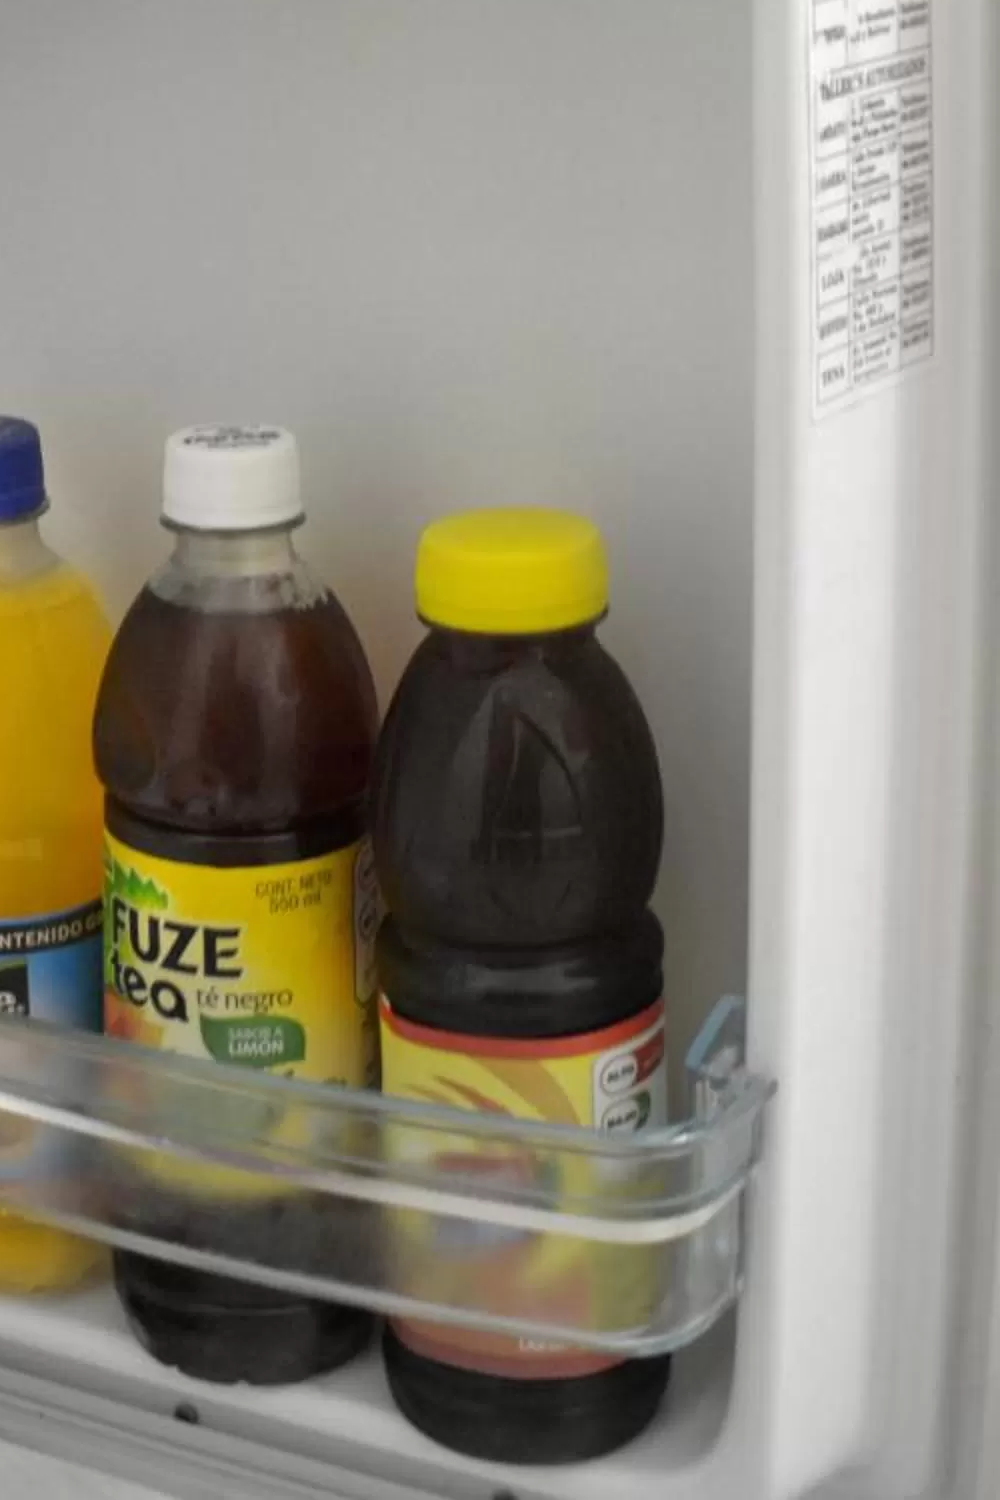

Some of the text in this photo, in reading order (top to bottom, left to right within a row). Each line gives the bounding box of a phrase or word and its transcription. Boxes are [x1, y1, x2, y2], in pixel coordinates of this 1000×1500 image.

[111, 896, 244, 979] FUZE
[111, 946, 190, 1024] tea
[196, 985, 294, 1013] té negro
